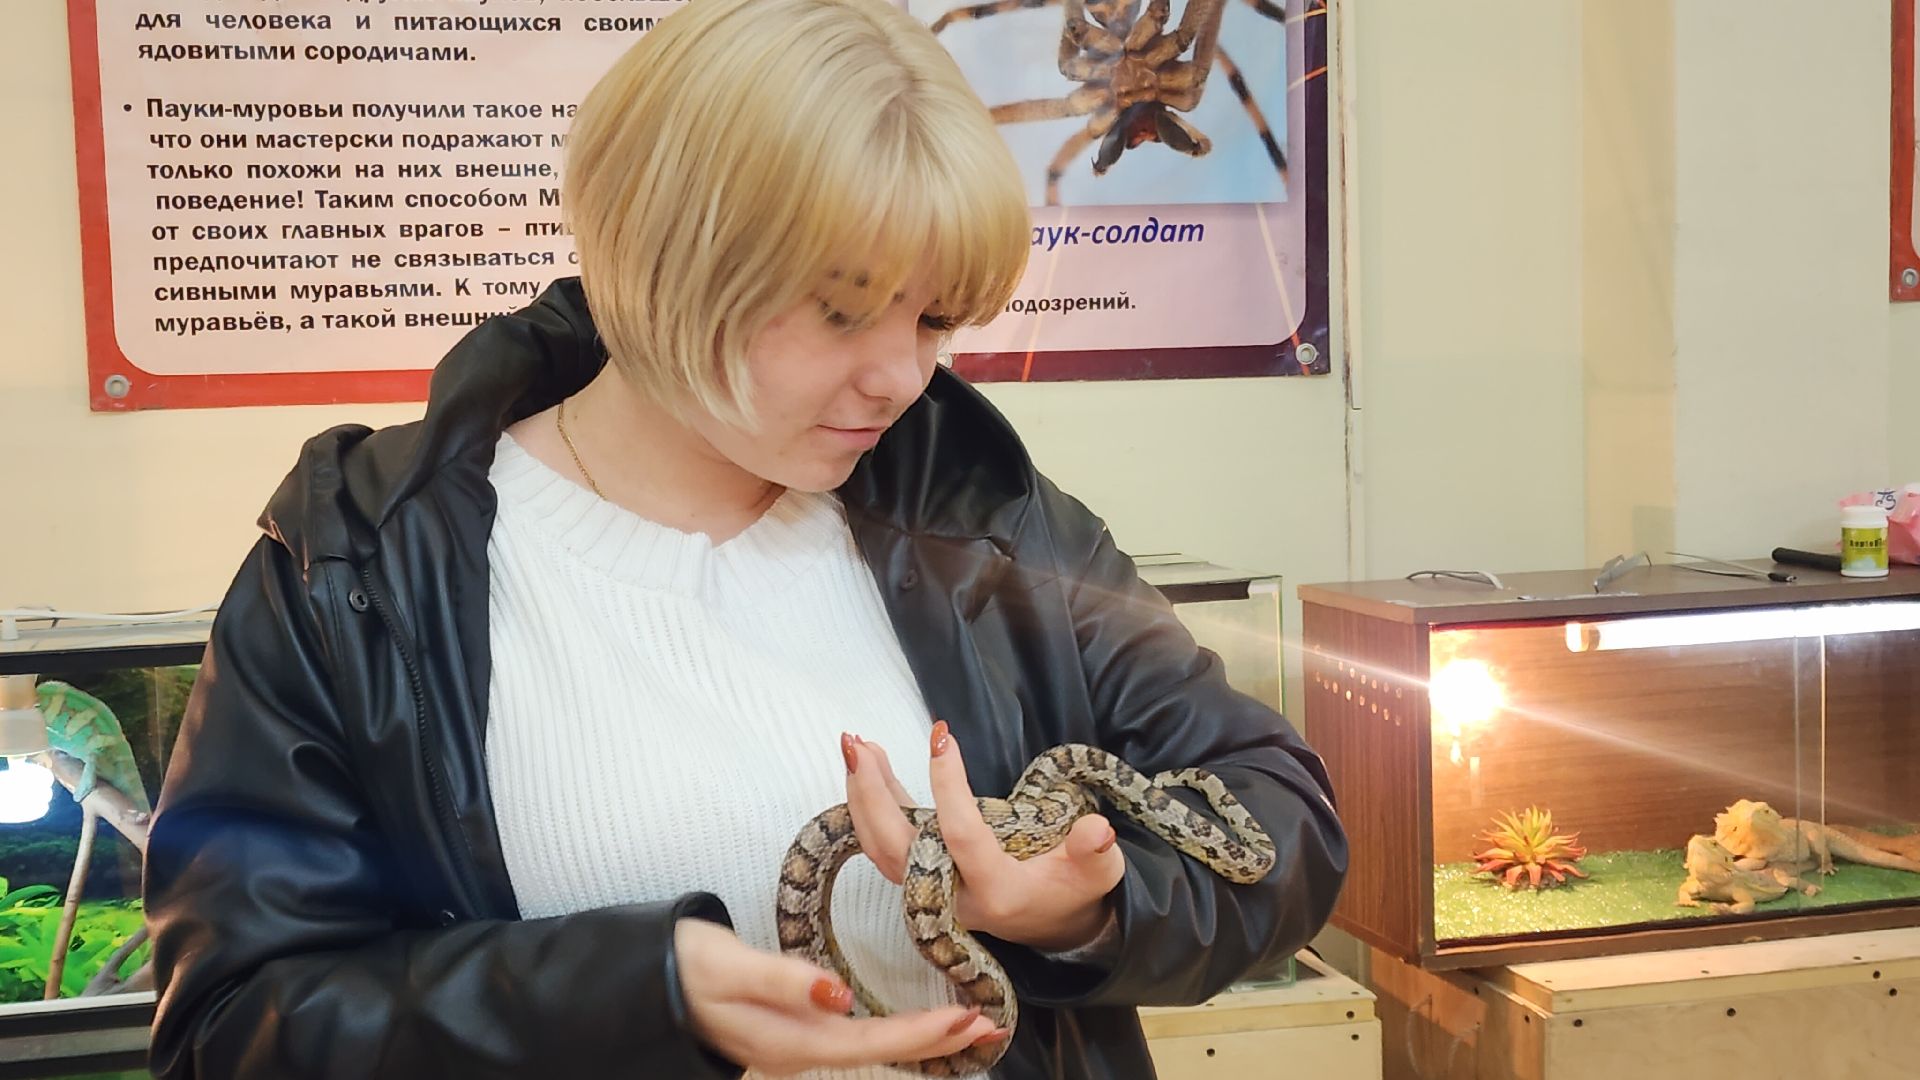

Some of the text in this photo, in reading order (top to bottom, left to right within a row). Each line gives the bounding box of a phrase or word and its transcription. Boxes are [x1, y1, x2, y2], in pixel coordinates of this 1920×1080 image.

[134, 13, 181, 31] для
[205, 14, 332, 30] человека
[355, 14, 371, 30] и
[394, 16, 562, 35] питающихся
[138, 44, 476, 65] ядовитыми сородичами.
[146, 97, 578, 123] Пауки-муровьи получили такое на
[149, 133, 192, 149] что
[200, 133, 247, 149] они
[255, 133, 393, 153] мастерски
[402, 133, 544, 153] подражают
[146, 163, 558, 181] только похожи на них внешне,
[156, 189, 304, 213] поведение!
[314, 189, 394, 209] Таким
[404, 187, 528, 208] способом
[151, 225, 180, 241] от
[191, 224, 269, 241] своих
[281, 224, 387, 240] главных
[399, 223, 484, 242] врагов
[1031, 216, 1205, 252] аук-солдат
[153, 254, 339, 275] предпочитают
[351, 254, 382, 269] не
[393, 251, 555, 268] связываться
[154, 277, 541, 304] сивными муравьями. К тому
[1004, 290, 1136, 315] одозрений.
[155, 310, 292, 335] муравьёв,
[299, 314, 315, 330] а
[321, 307, 396, 329] такой
